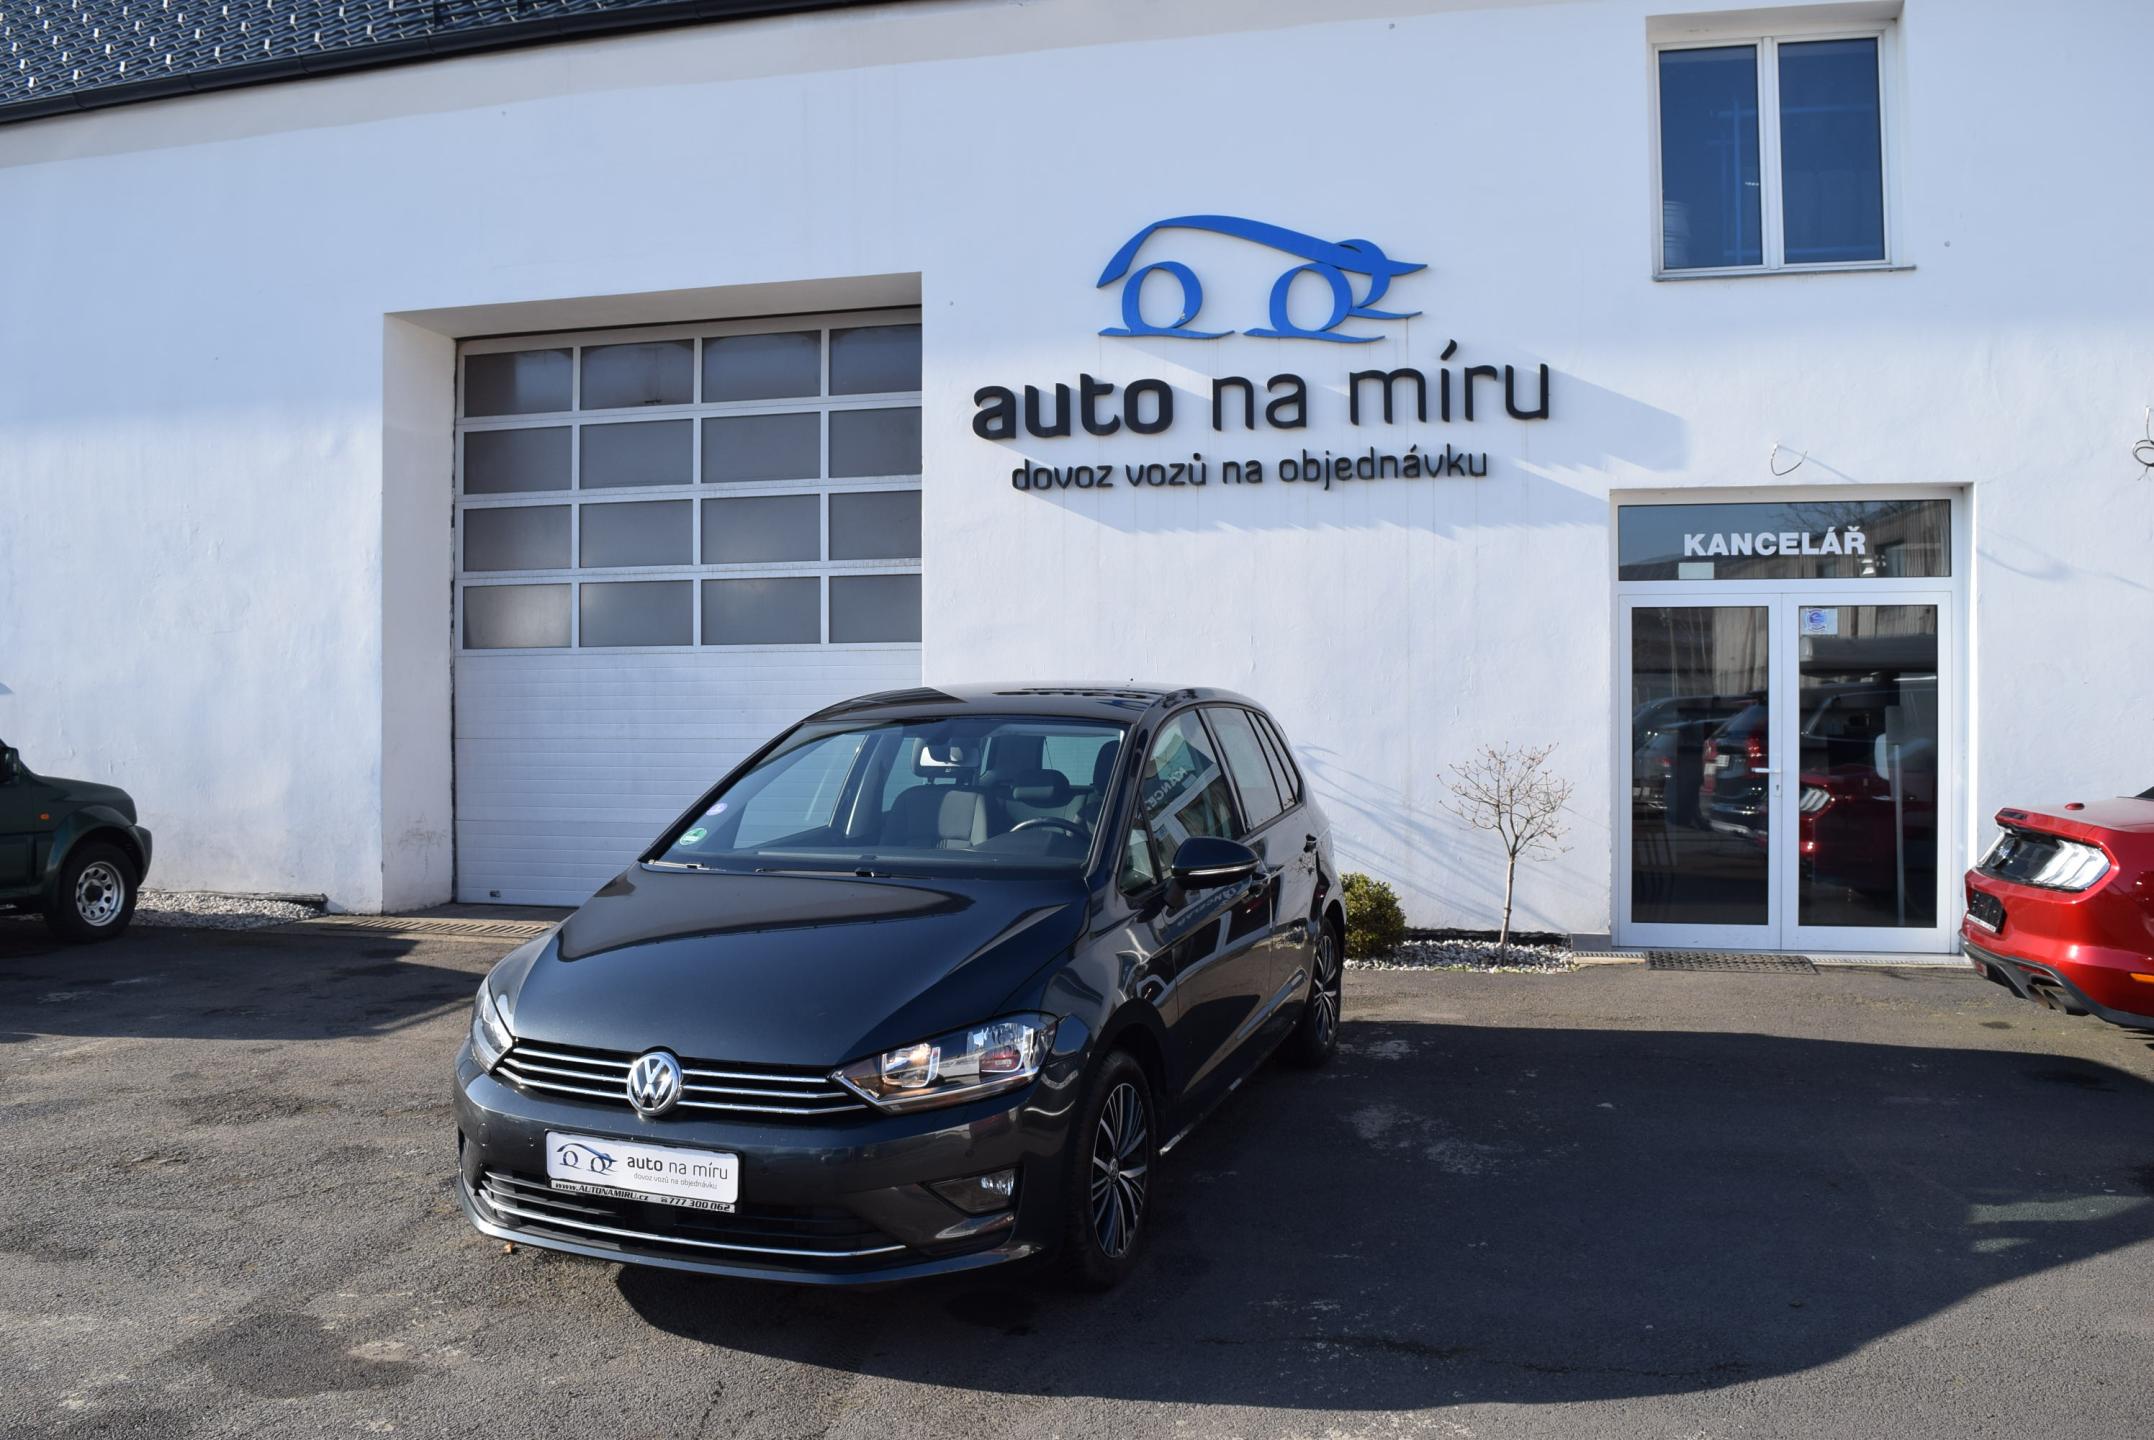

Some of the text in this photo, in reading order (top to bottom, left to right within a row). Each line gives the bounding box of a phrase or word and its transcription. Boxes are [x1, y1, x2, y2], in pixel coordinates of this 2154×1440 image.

[972, 338, 1549, 440] auto na míru
[1011, 443, 1487, 491] dovoz vozů na objednávku
[1684, 525, 1866, 557] KANCELÁŘ
[627, 1156, 728, 1180] auto na míru
[633, 1172, 653, 1181] dovoz
[669, 1197, 687, 1206] 777
[689, 1200, 708, 1209] 300
[710, 1203, 730, 1212] 062
